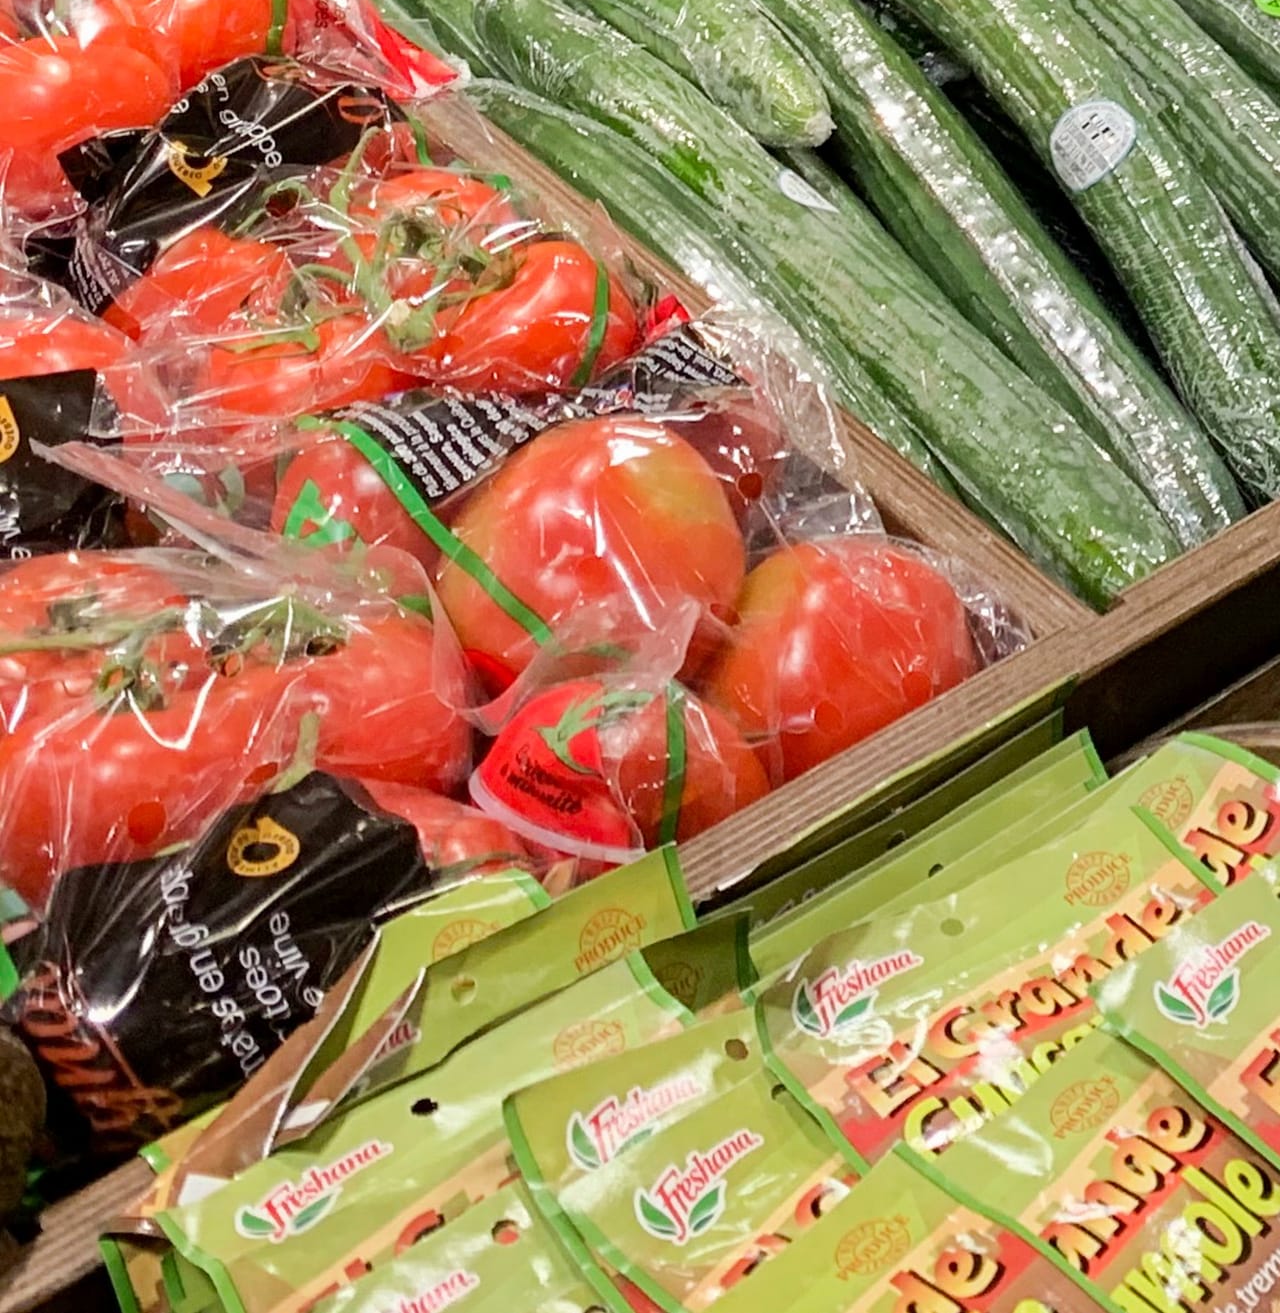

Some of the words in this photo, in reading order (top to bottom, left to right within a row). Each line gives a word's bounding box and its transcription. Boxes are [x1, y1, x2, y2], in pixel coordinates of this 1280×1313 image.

[211, 72, 230, 104] en
[189, 951, 224, 993] en
[269, 911, 311, 979] vine
[1174, 922, 1265, 1023] Freshana
[812, 951, 918, 1036] Freshana
[845, 1040, 947, 1118] El
[261, 1141, 386, 1239] Freshana
[657, 1128, 757, 1239] Freshana
